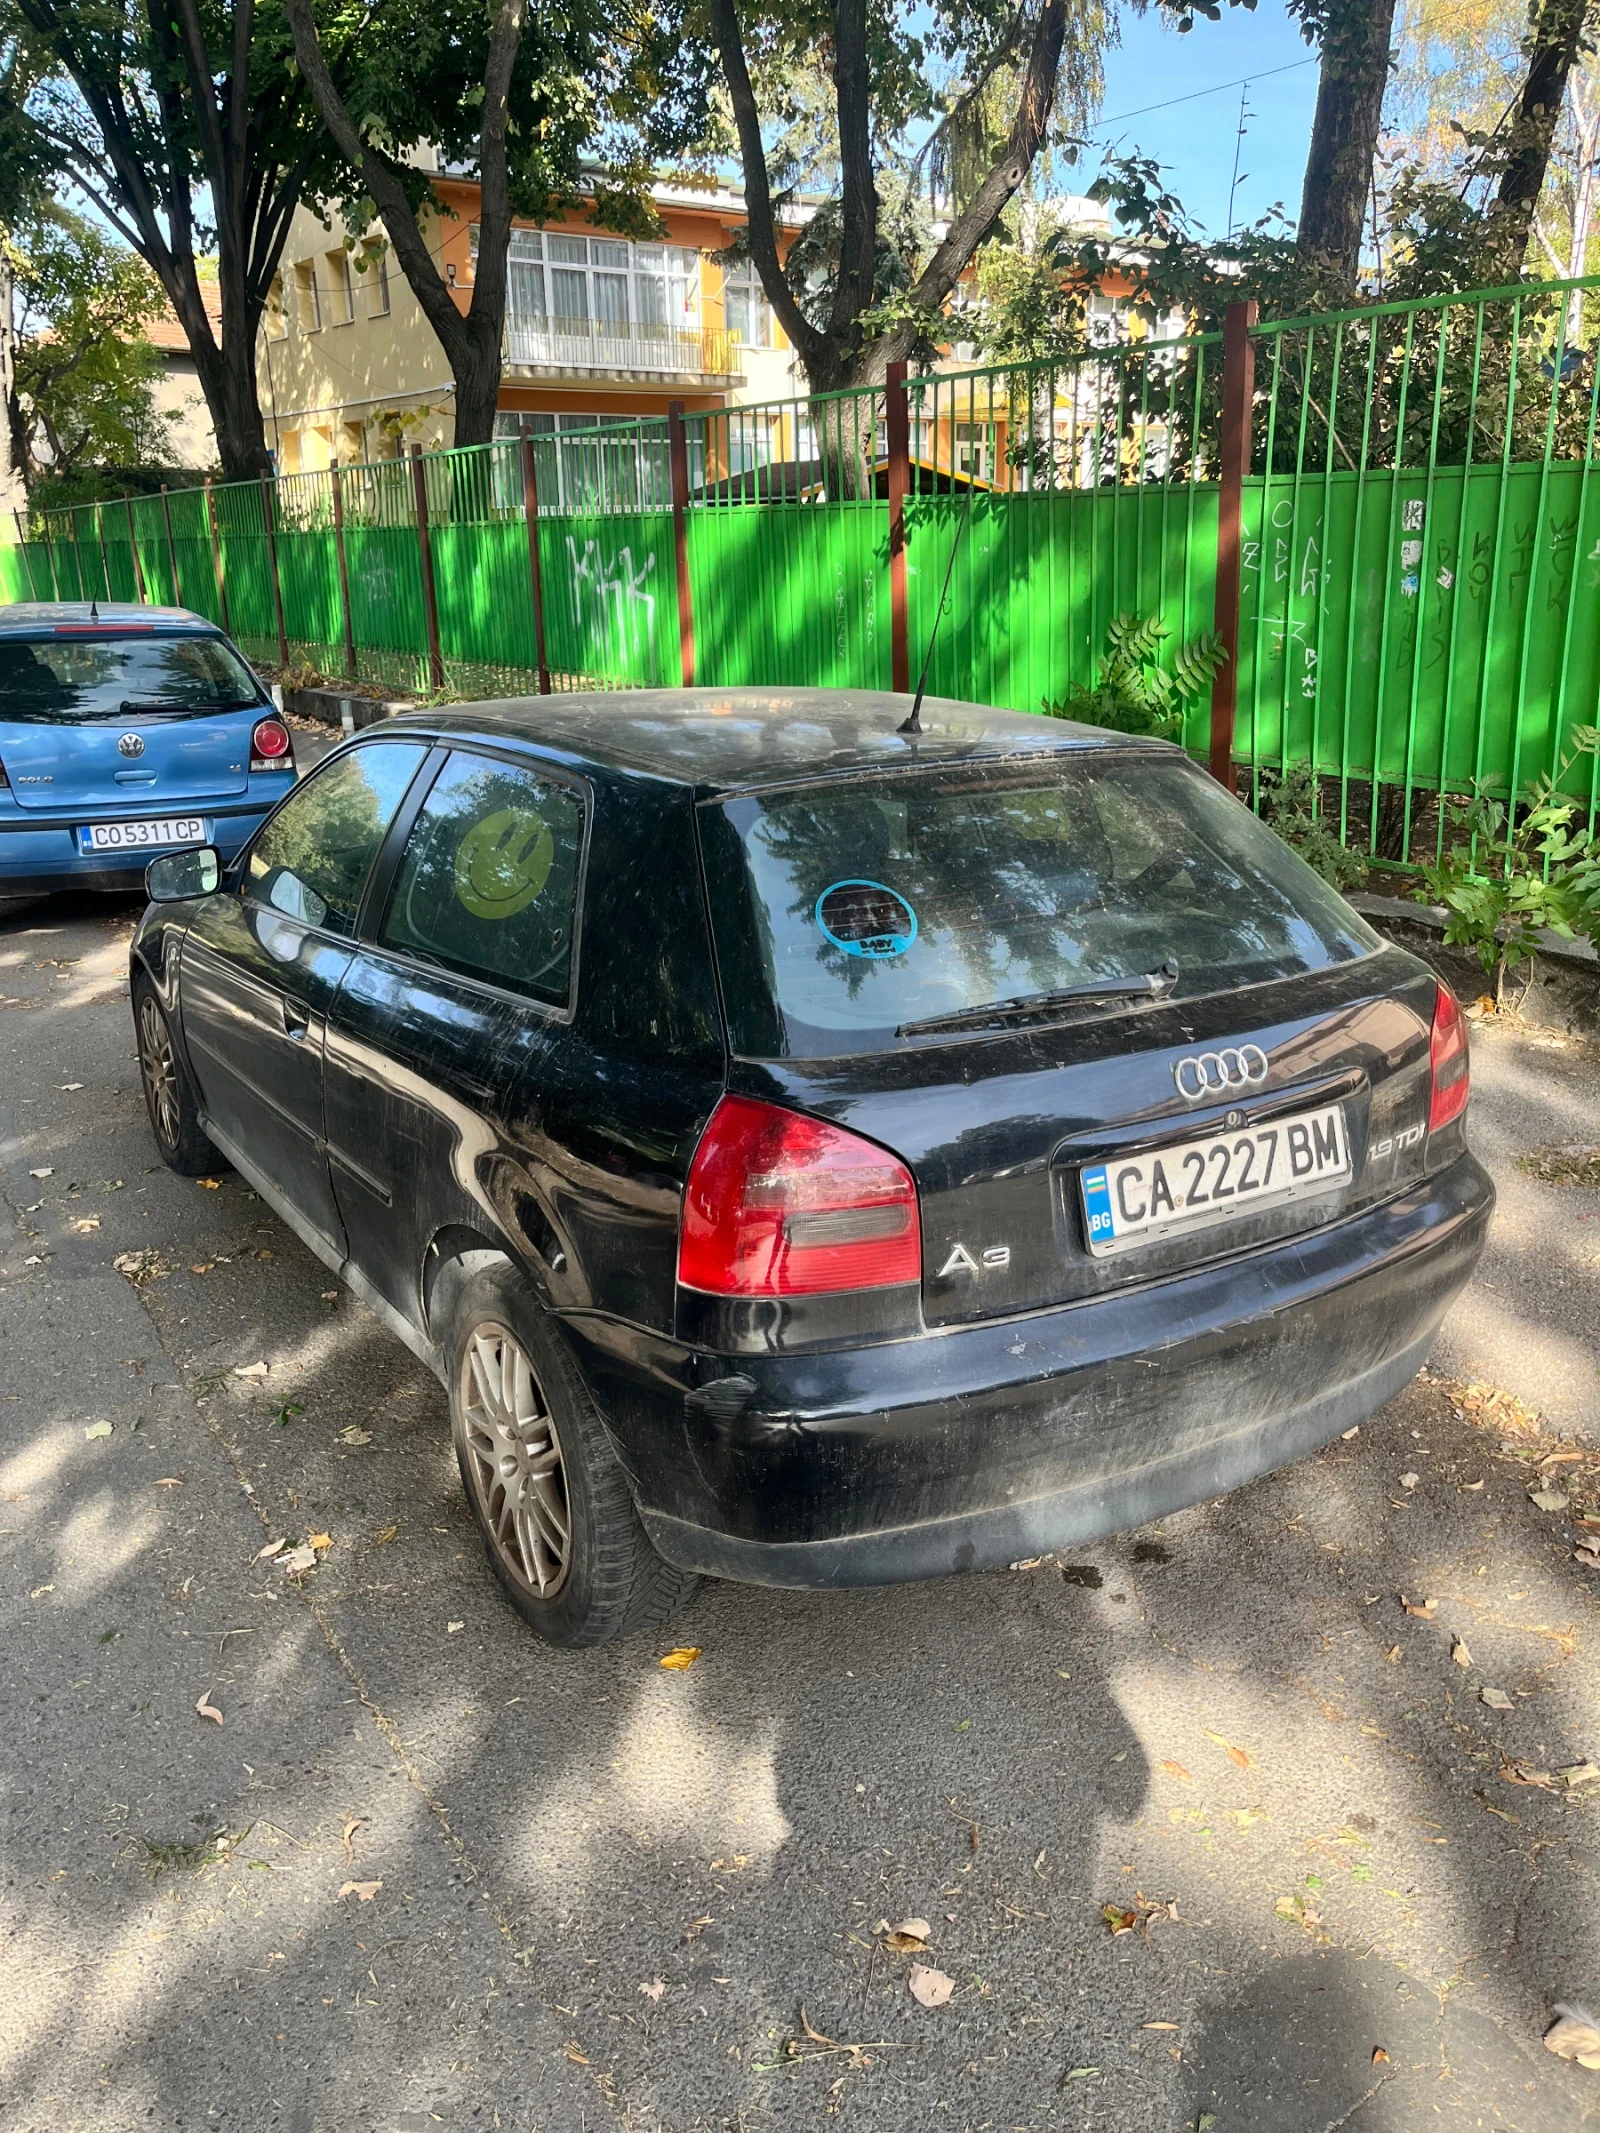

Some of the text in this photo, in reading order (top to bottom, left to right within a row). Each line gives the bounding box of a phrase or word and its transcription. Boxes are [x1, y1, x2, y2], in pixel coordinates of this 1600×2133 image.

[18, 775, 54, 784] POLO
[95, 821, 200, 845] CO 5311 CP
[859, 939, 892, 949] BABY
[1395, 1122, 1425, 1149] TDI
[1116, 1115, 1340, 1223] CA 2227 BM
[1091, 1211, 1111, 1232] BG
[935, 1244, 1010, 1277] A3
